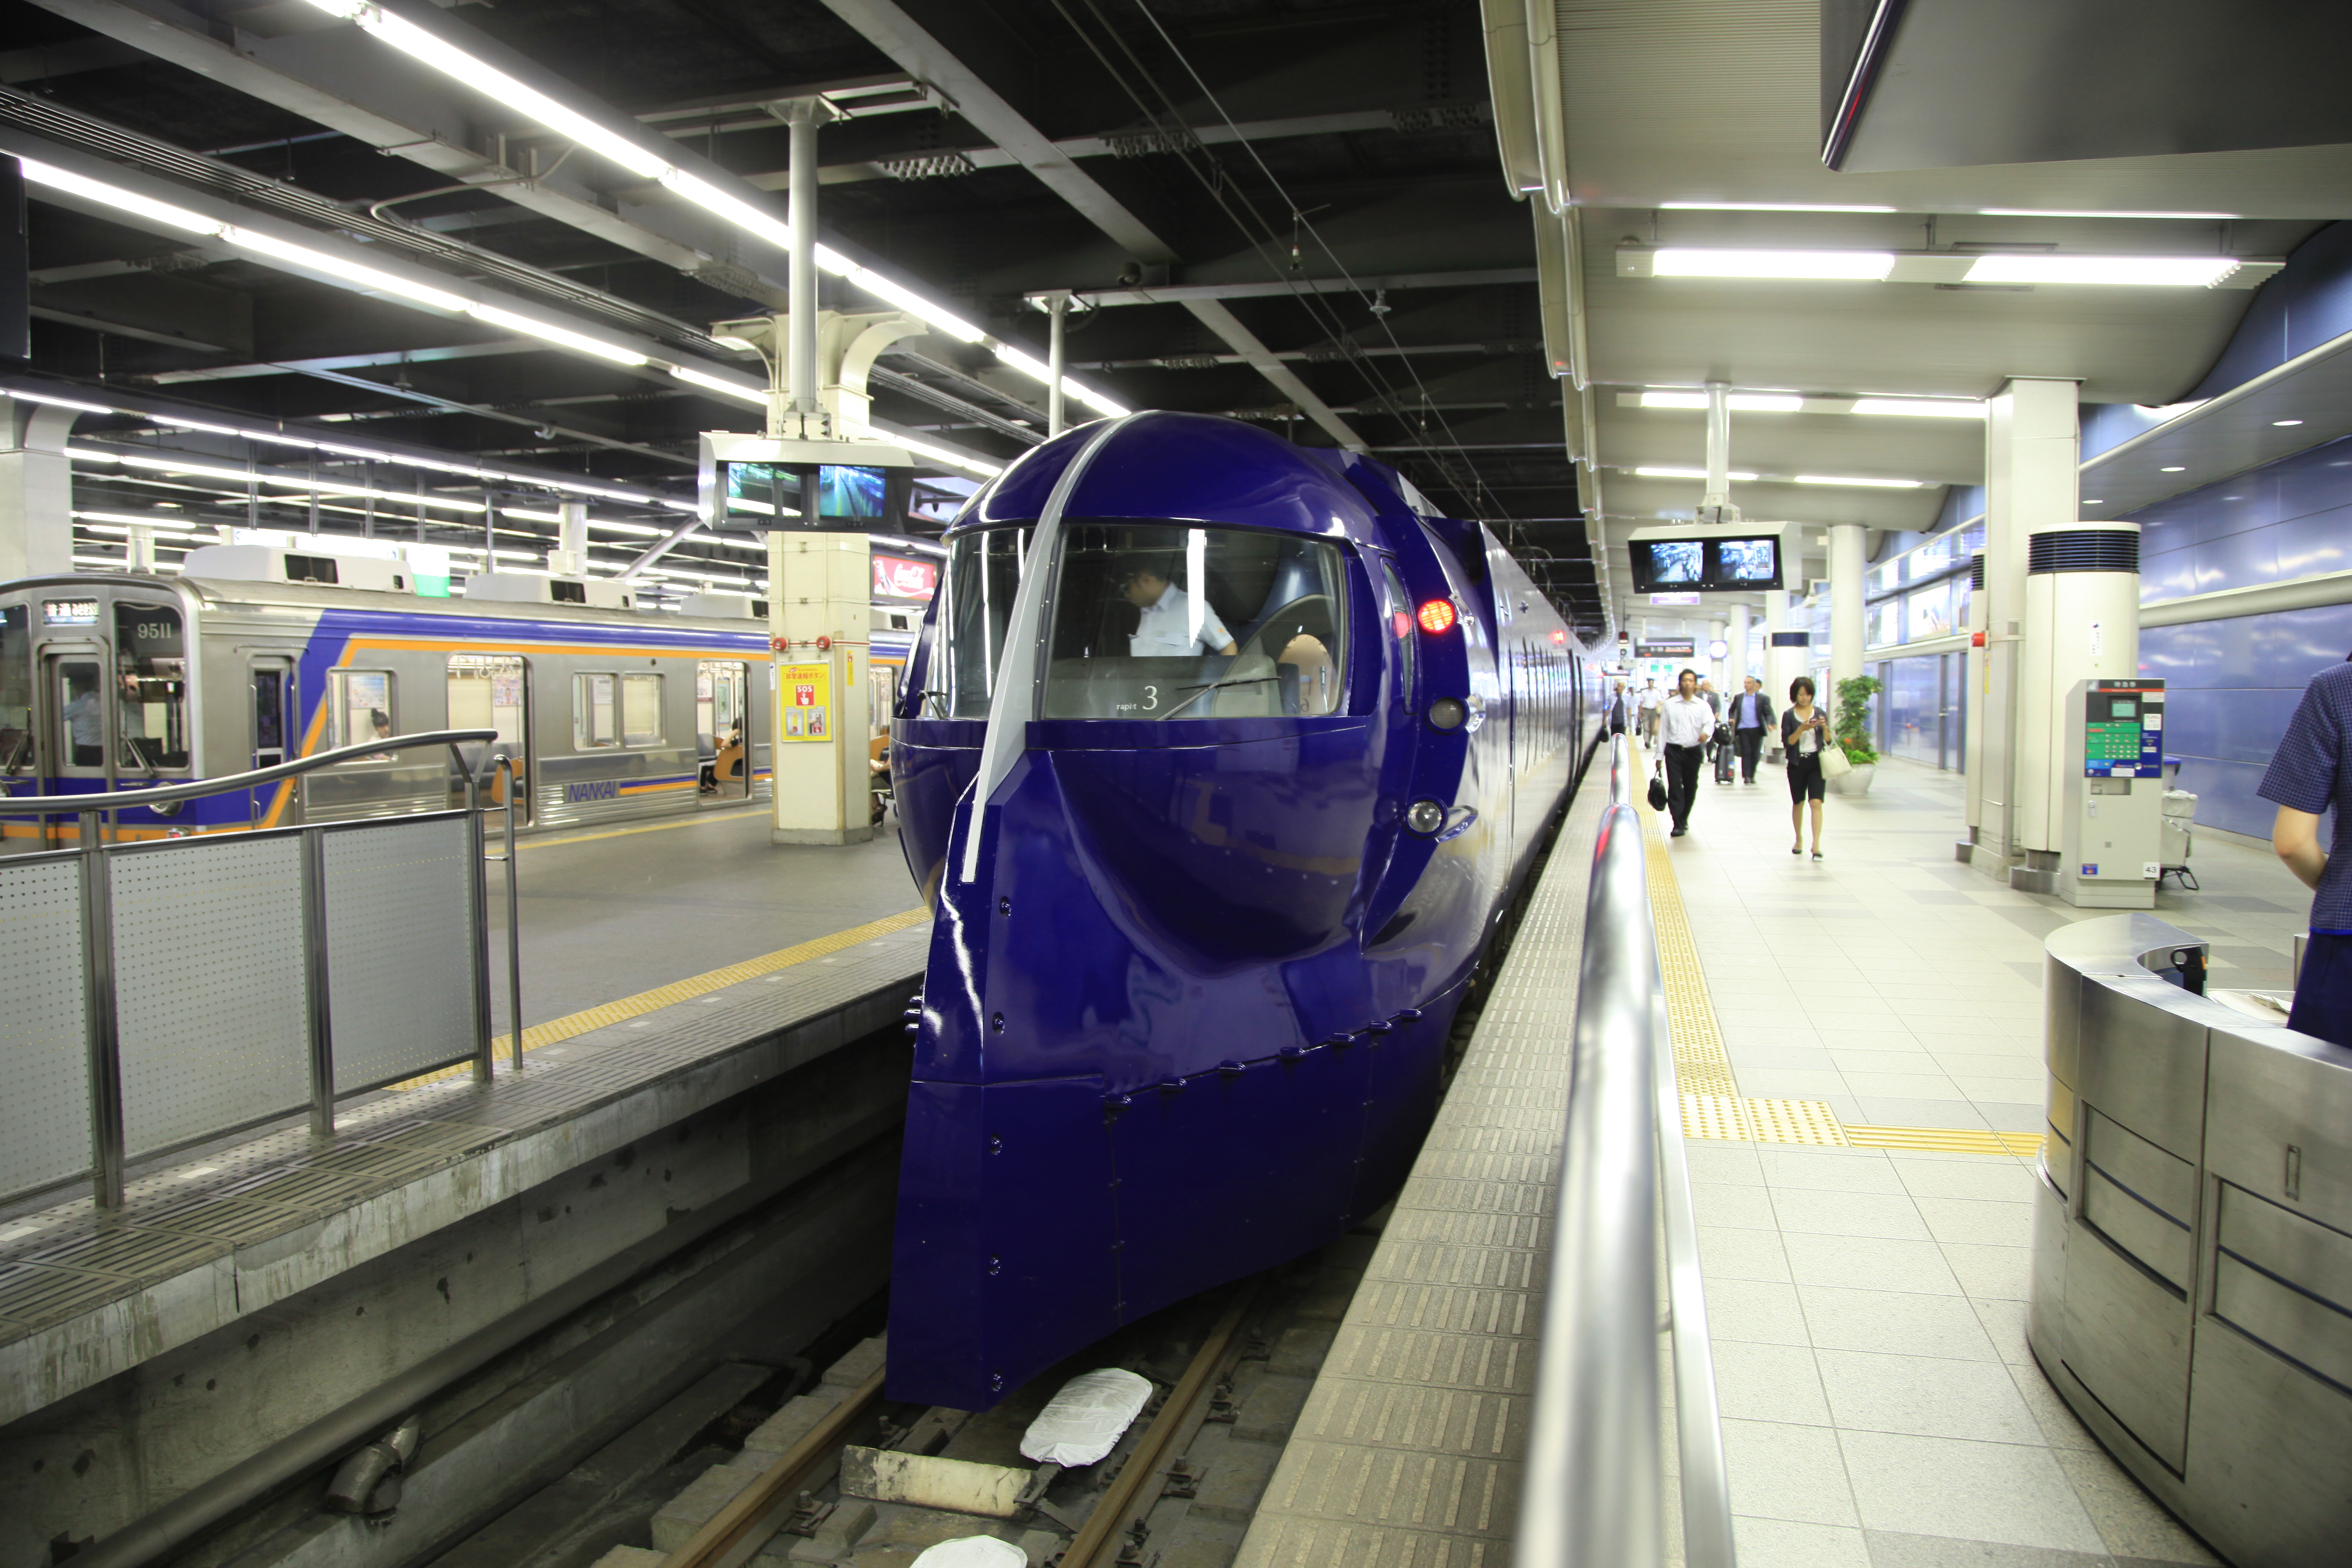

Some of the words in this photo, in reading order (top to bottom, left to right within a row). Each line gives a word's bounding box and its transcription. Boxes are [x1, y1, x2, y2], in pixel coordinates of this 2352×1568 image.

[137, 623, 171, 639] 9511
[1142, 686, 1158, 710] 3
[568, 780, 616, 802] NANKAI
